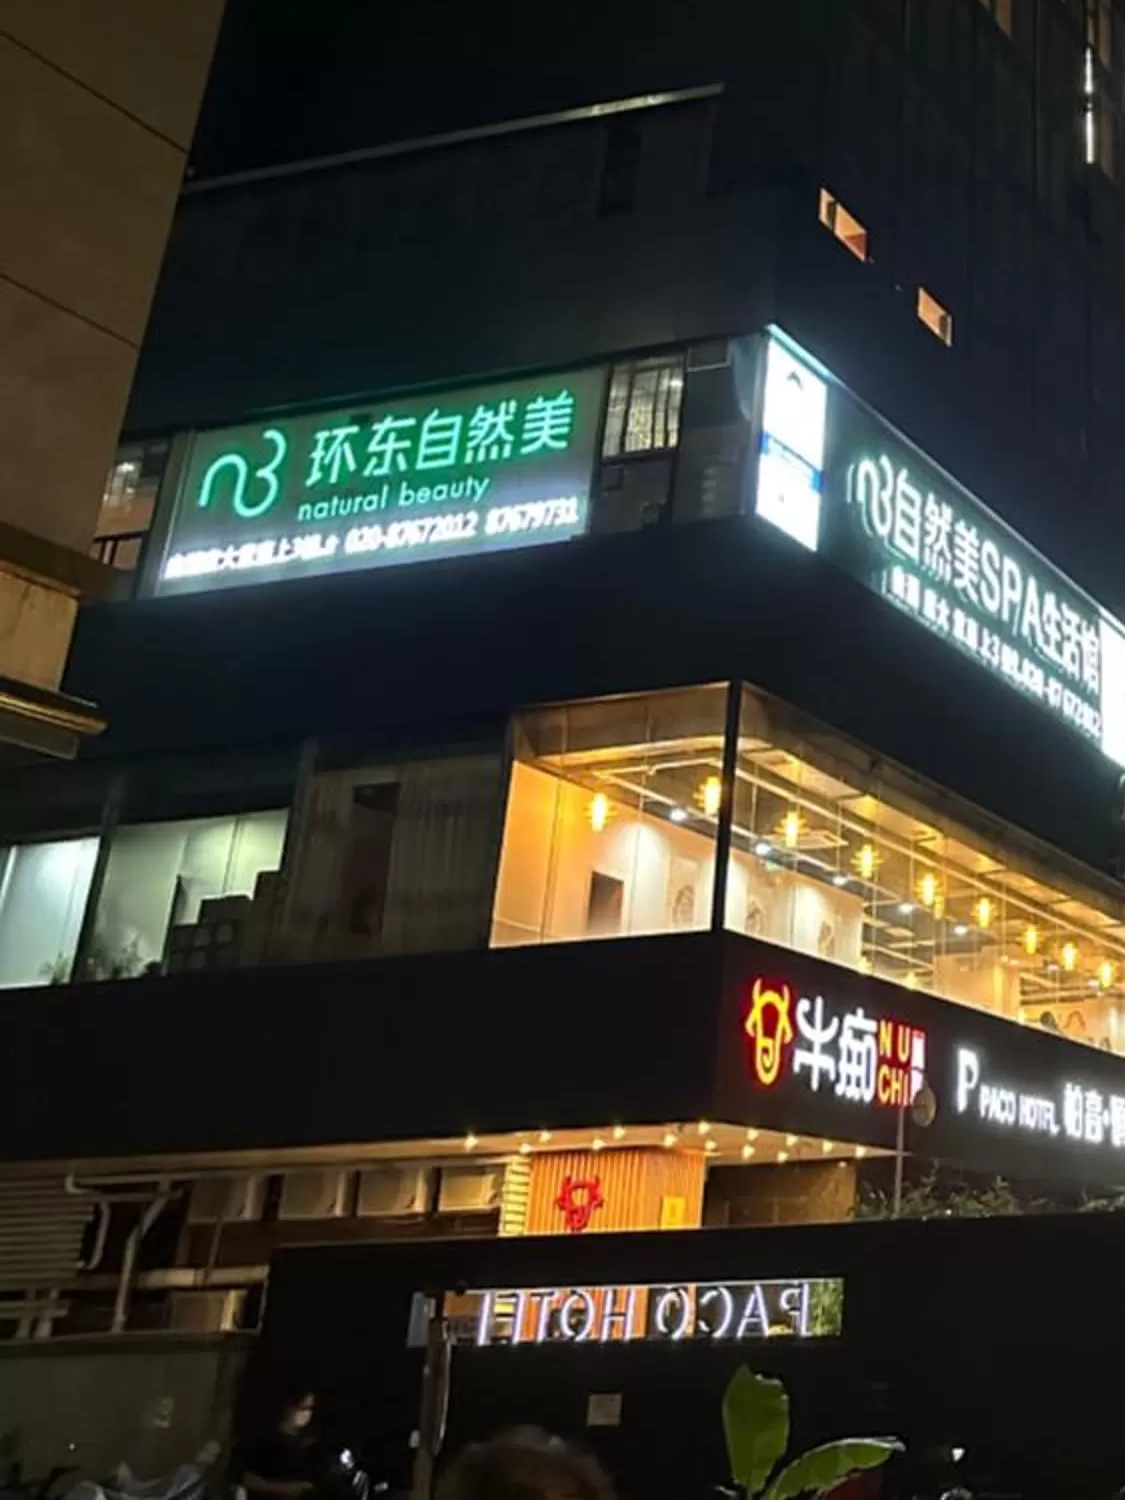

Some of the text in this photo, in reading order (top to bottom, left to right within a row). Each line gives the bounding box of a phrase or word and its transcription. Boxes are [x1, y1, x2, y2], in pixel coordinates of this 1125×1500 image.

[305, 389, 574, 488] 环东自然美
[297, 476, 490, 521] natural beauty
[877, 1063, 910, 1106] CHI
[979, 1083, 1017, 1127] PACO
[1018, 1093, 1060, 1136] HOTEL
